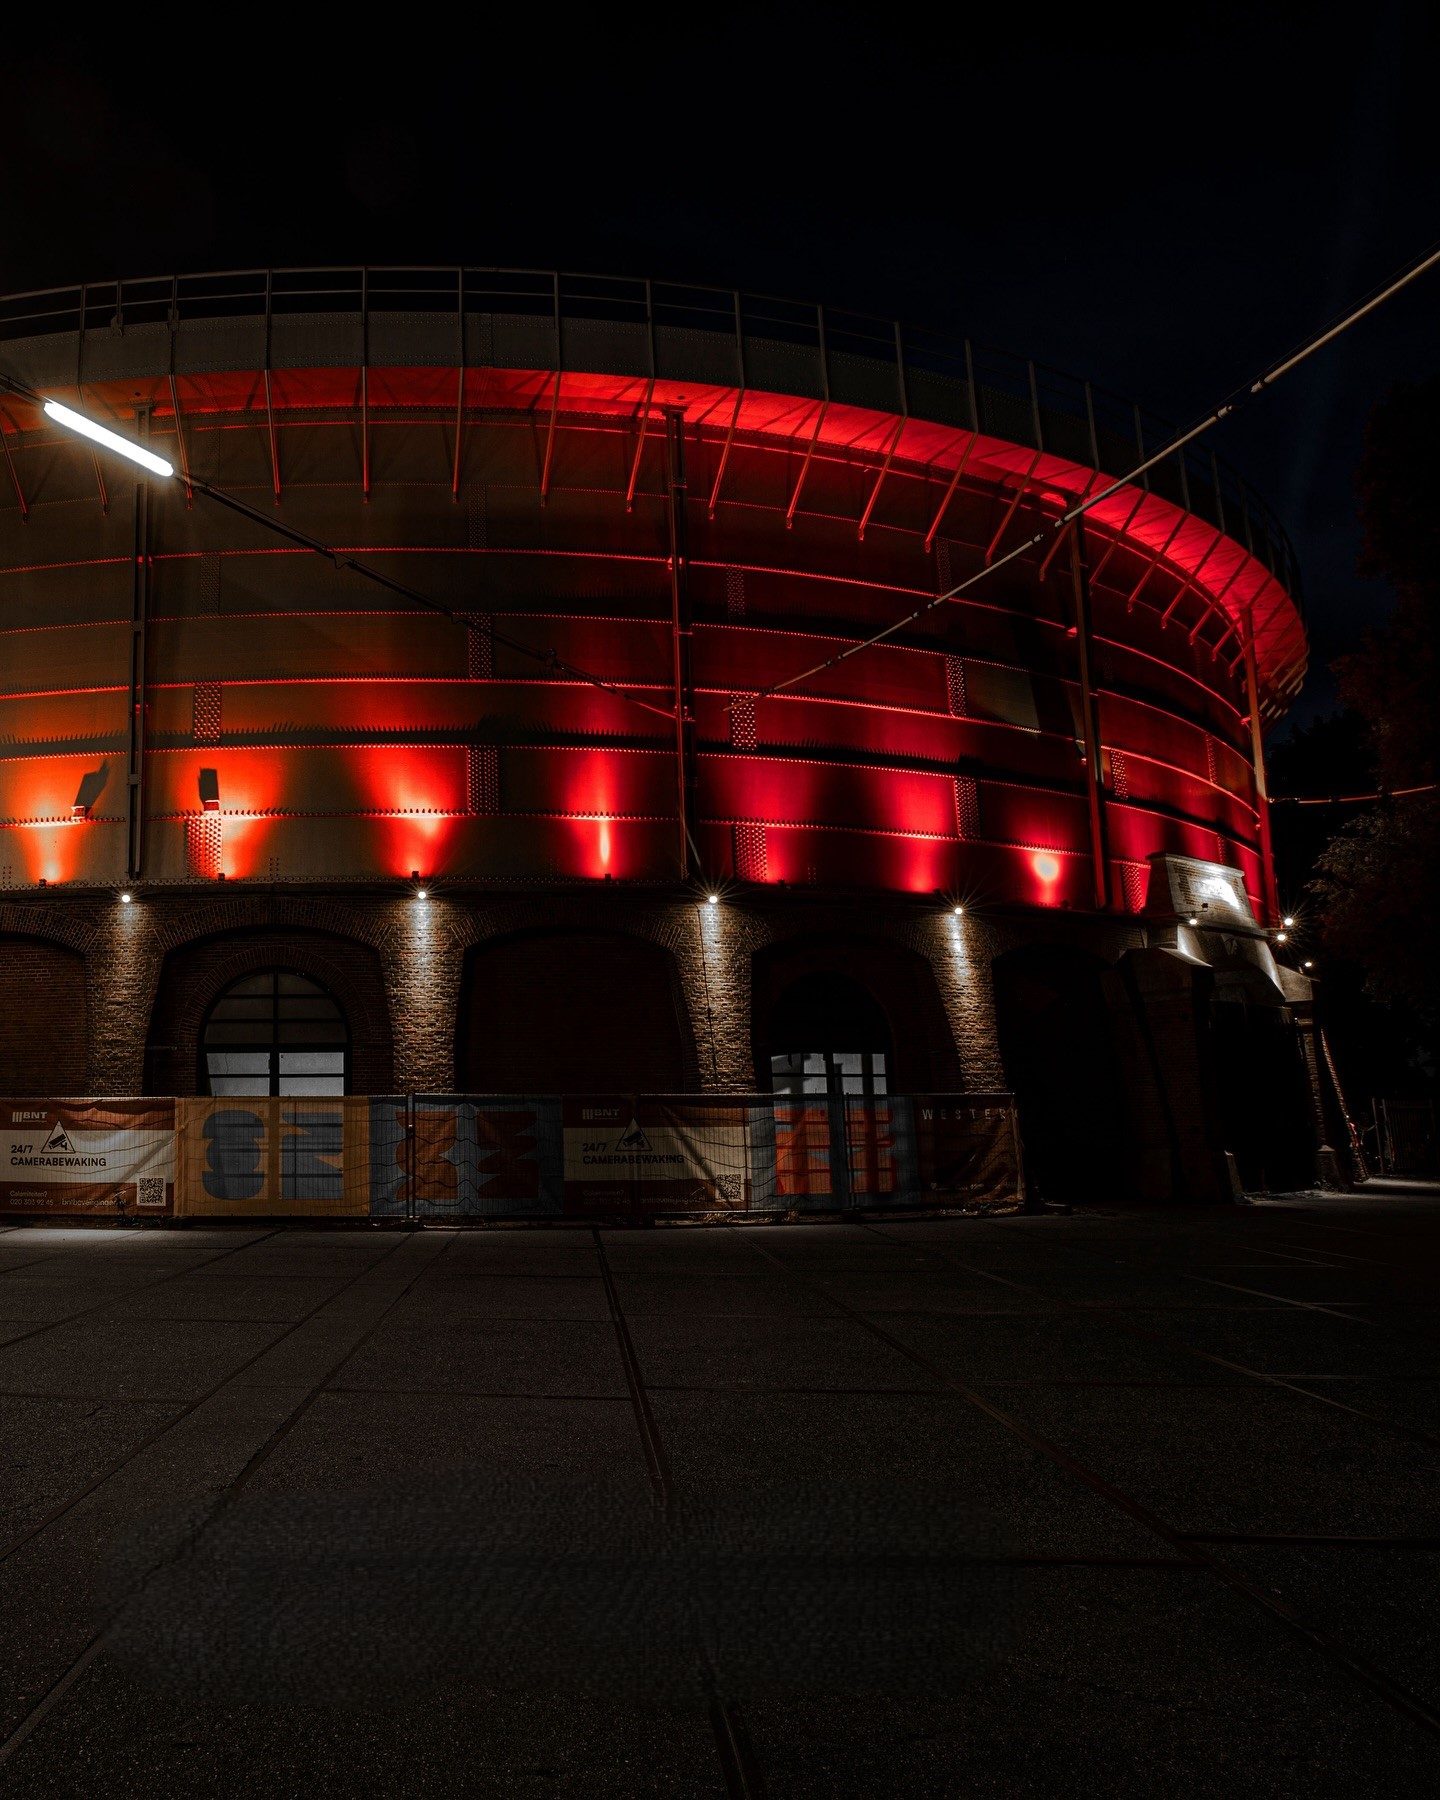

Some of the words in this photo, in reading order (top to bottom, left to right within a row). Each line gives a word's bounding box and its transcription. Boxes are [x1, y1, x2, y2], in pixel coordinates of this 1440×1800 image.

[23, 1111, 48, 1119] BNT
[594, 1108, 620, 1116] BNT
[11, 1144, 33, 1154] 24/7
[582, 1143, 607, 1152] 24/7
[10, 1156, 107, 1167] CAMERABEWAKING
[583, 1154, 685, 1165] CAMERABEWAKING
